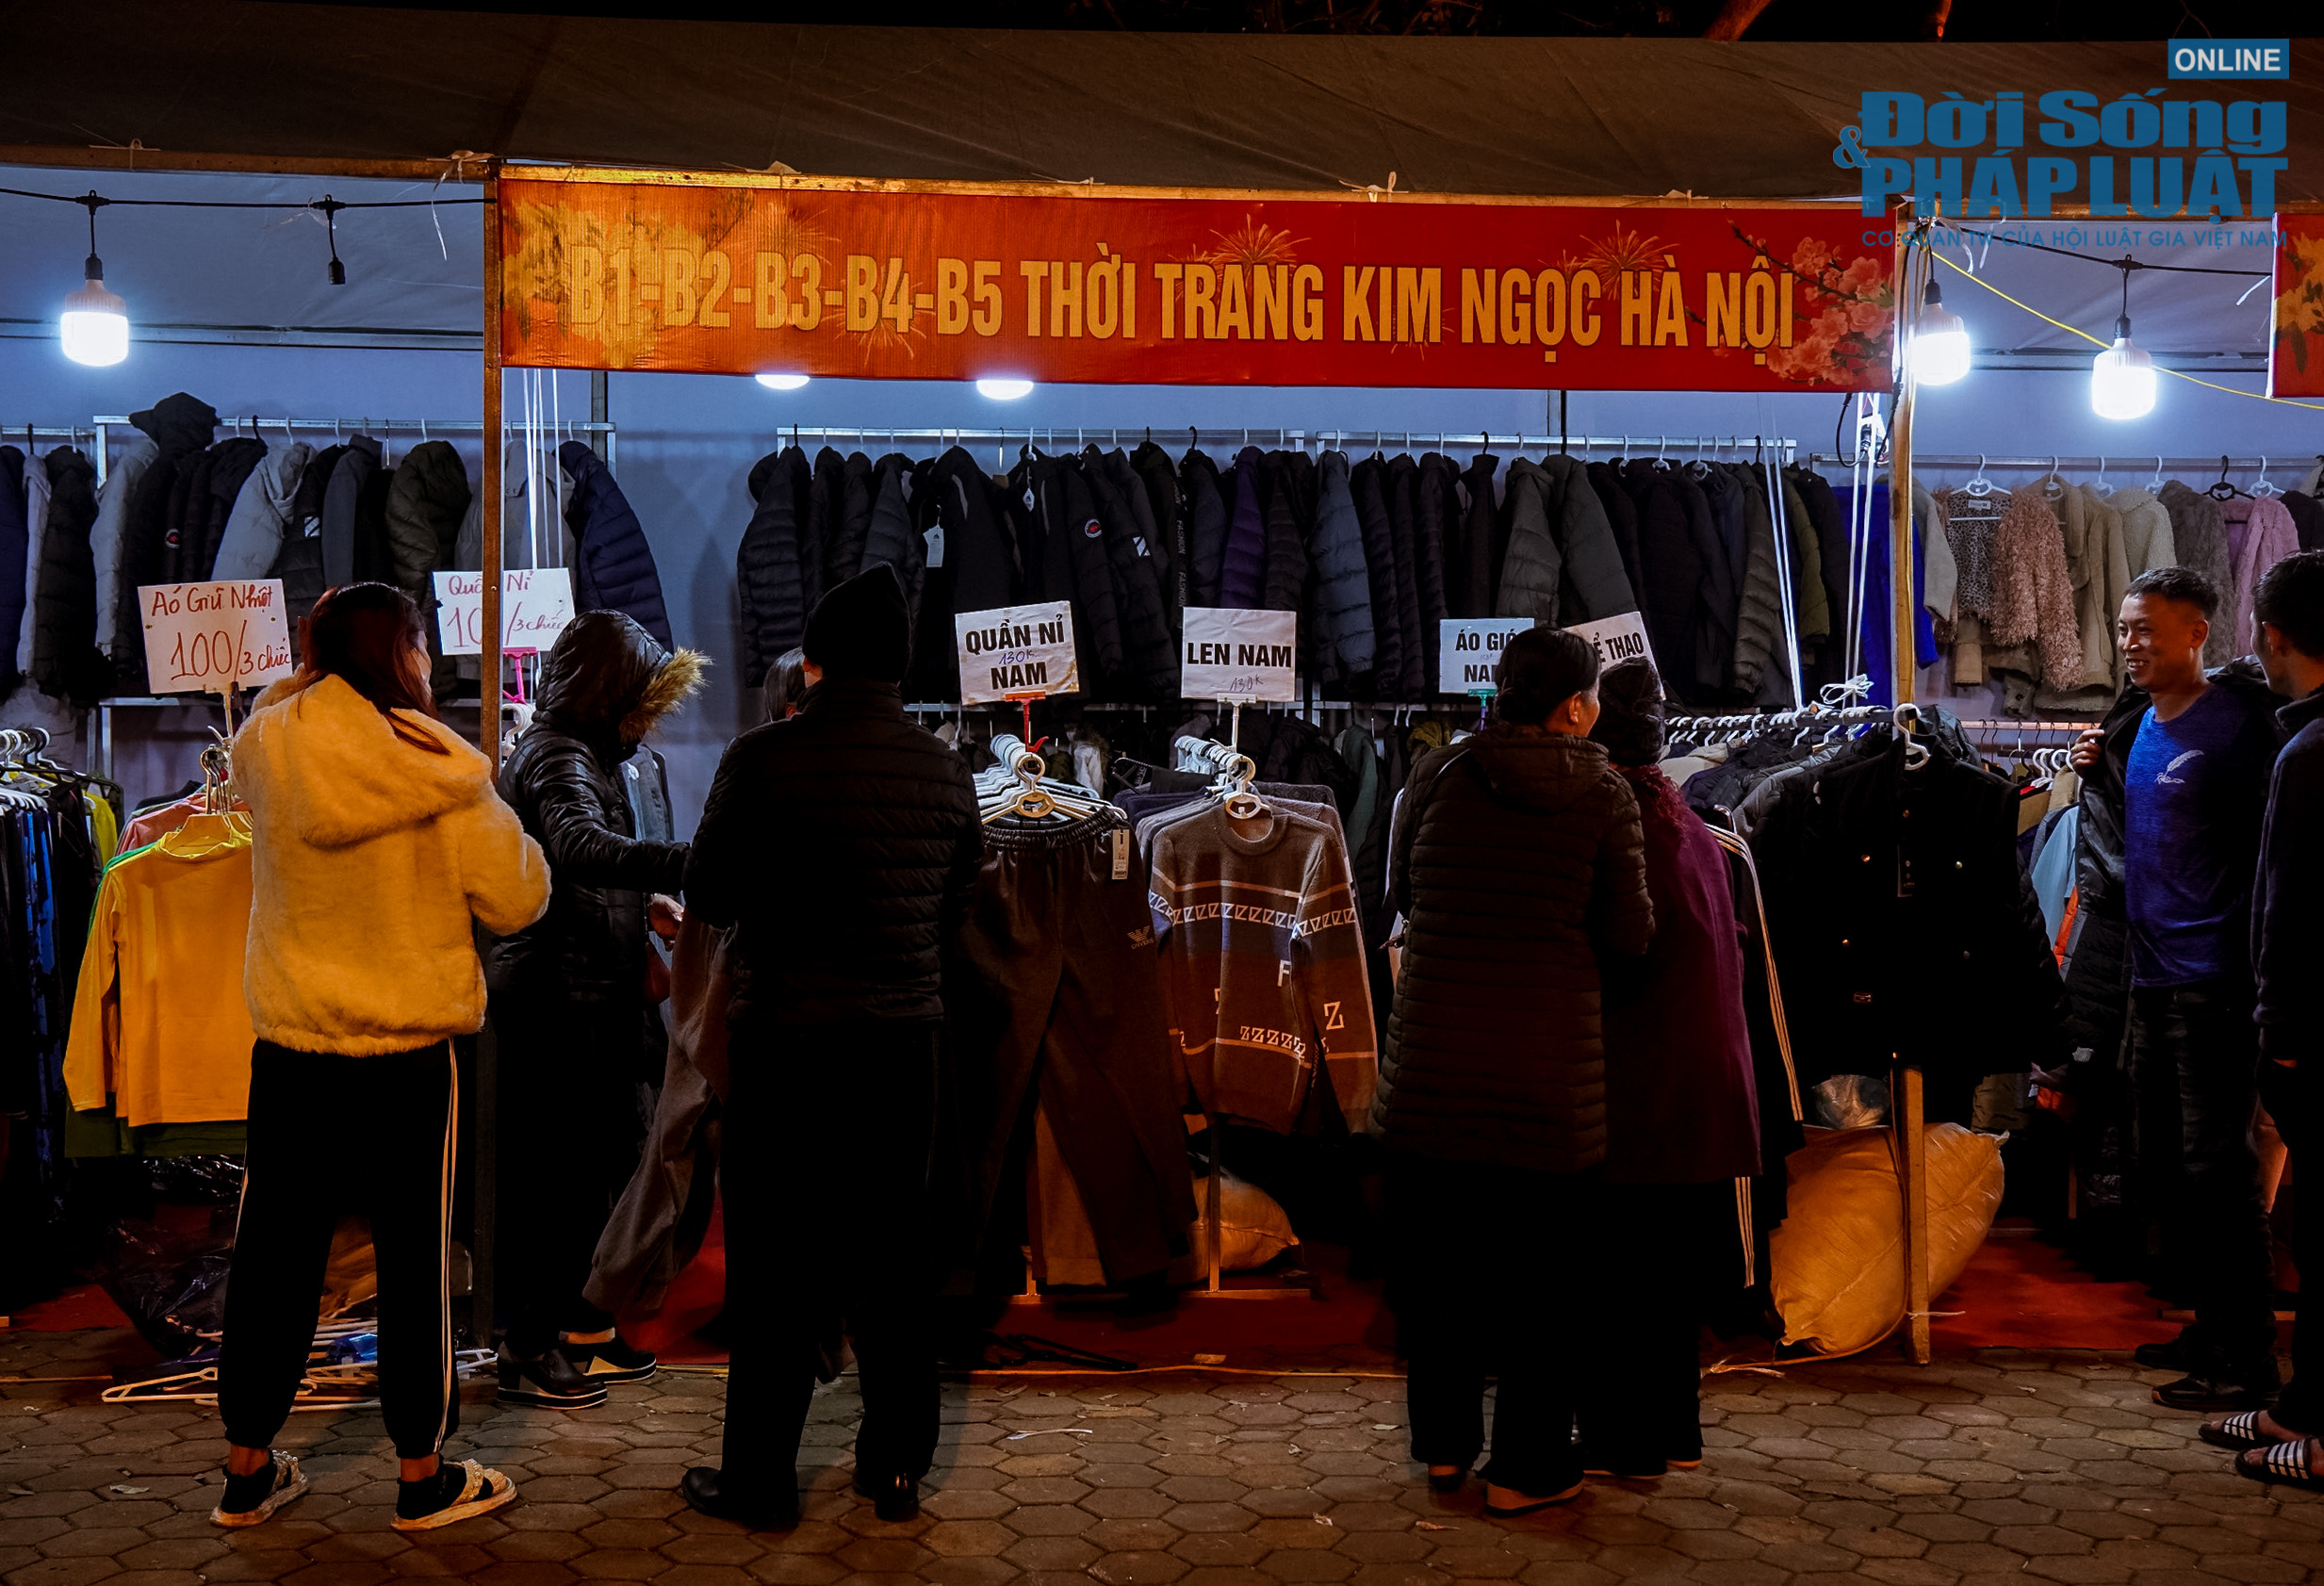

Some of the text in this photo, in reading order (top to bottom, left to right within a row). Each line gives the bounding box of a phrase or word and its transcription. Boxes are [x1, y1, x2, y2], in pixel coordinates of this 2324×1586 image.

[570, 241, 1792, 366] B1-B2-B3-B4-B5 THỜI TRANG KIM NGỌC HÀ NỘI
[1177, 519, 1187, 554] FASHION
[1178, 571, 1187, 607] FASHION
[965, 613, 1064, 656] QUẦN NỈ
[1455, 629, 1480, 651] ÁO
[1605, 632, 1645, 661] THAO
[1187, 642, 1292, 668] LEN NAM
[990, 662, 1048, 691] NAM
